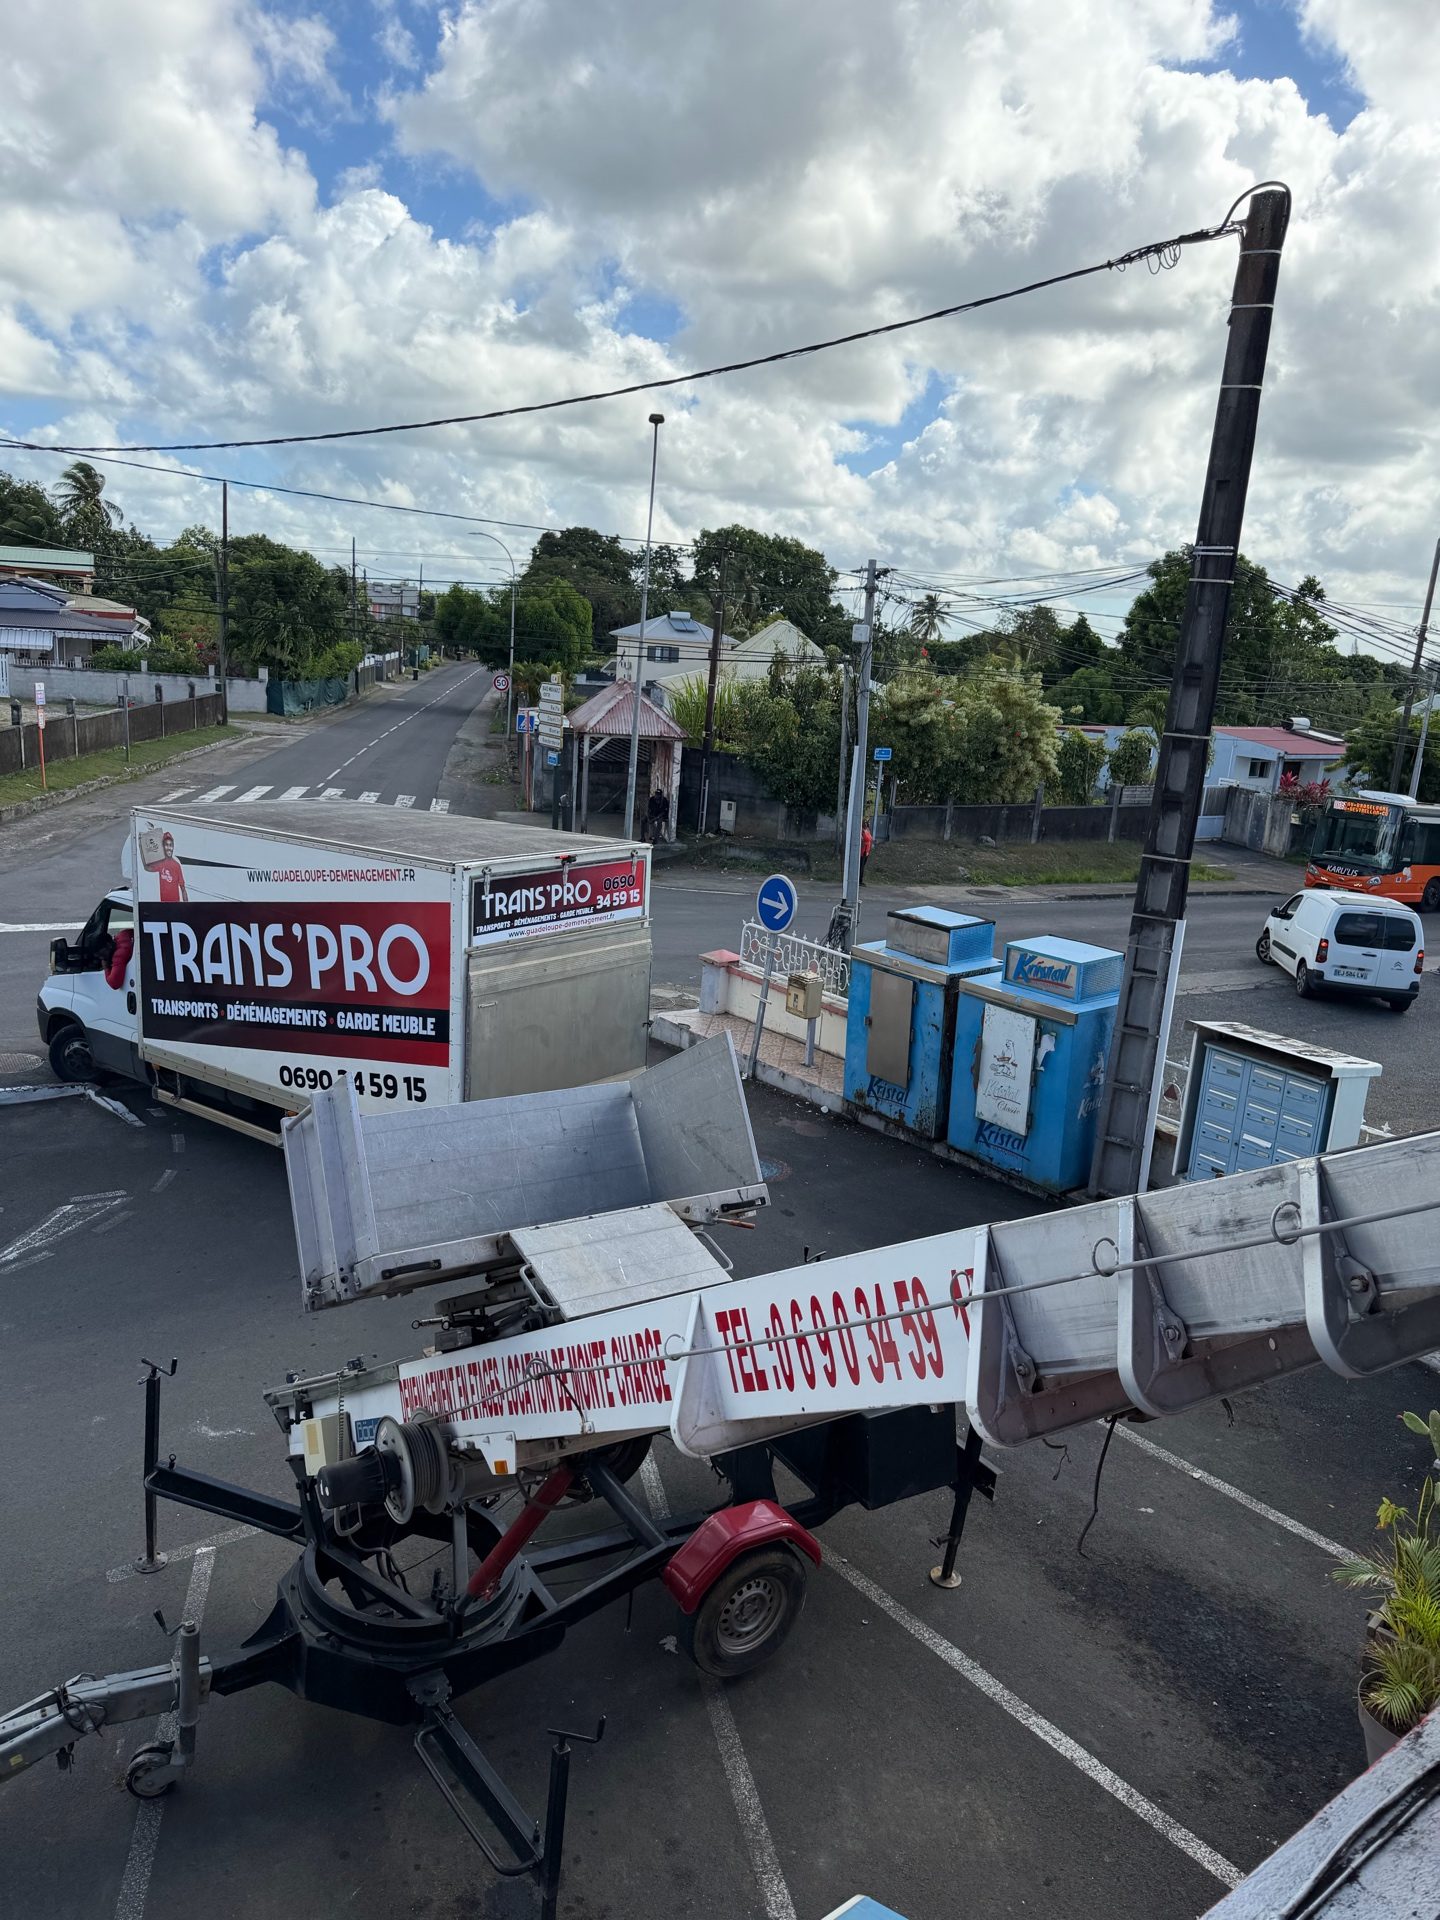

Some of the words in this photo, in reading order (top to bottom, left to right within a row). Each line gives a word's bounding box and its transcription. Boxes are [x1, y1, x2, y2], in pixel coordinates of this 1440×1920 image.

[247, 868, 416, 882] WWW.GUADELOUPE-DEMENAGEMENT.FR
[603, 874, 635, 891] 0690
[1326, 864, 1359, 877] KARU'LIS
[481, 879, 592, 919] TRANS'PRO
[596, 894, 611, 909] 34
[612, 890, 627, 906] 59
[629, 889, 640, 903] 15
[476, 921, 511, 934] TRANSPORTS
[508, 913, 615, 938] www.guadeloupe-demenagement.fr
[143, 921, 430, 996] TRANS'PRO
[1013, 952, 1072, 983] Kristal
[151, 998, 218, 1019] TRANSPORTS
[226, 1001, 327, 1028] DÉMÉNAGEMENTS
[336, 1011, 380, 1032] GARDE
[382, 1015, 436, 1036] MEUBLE
[279, 1065, 333, 1090] 0690
[337, 1069, 365, 1096] 4
[369, 1072, 398, 1099] 59
[403, 1076, 427, 1102] 15
[867, 1075, 910, 1105] Kristal
[975, 1119, 1028, 1151] Kristal
[567, 1340, 615, 1411] MONTE
[611, 1327, 673, 1407] CHARGE
